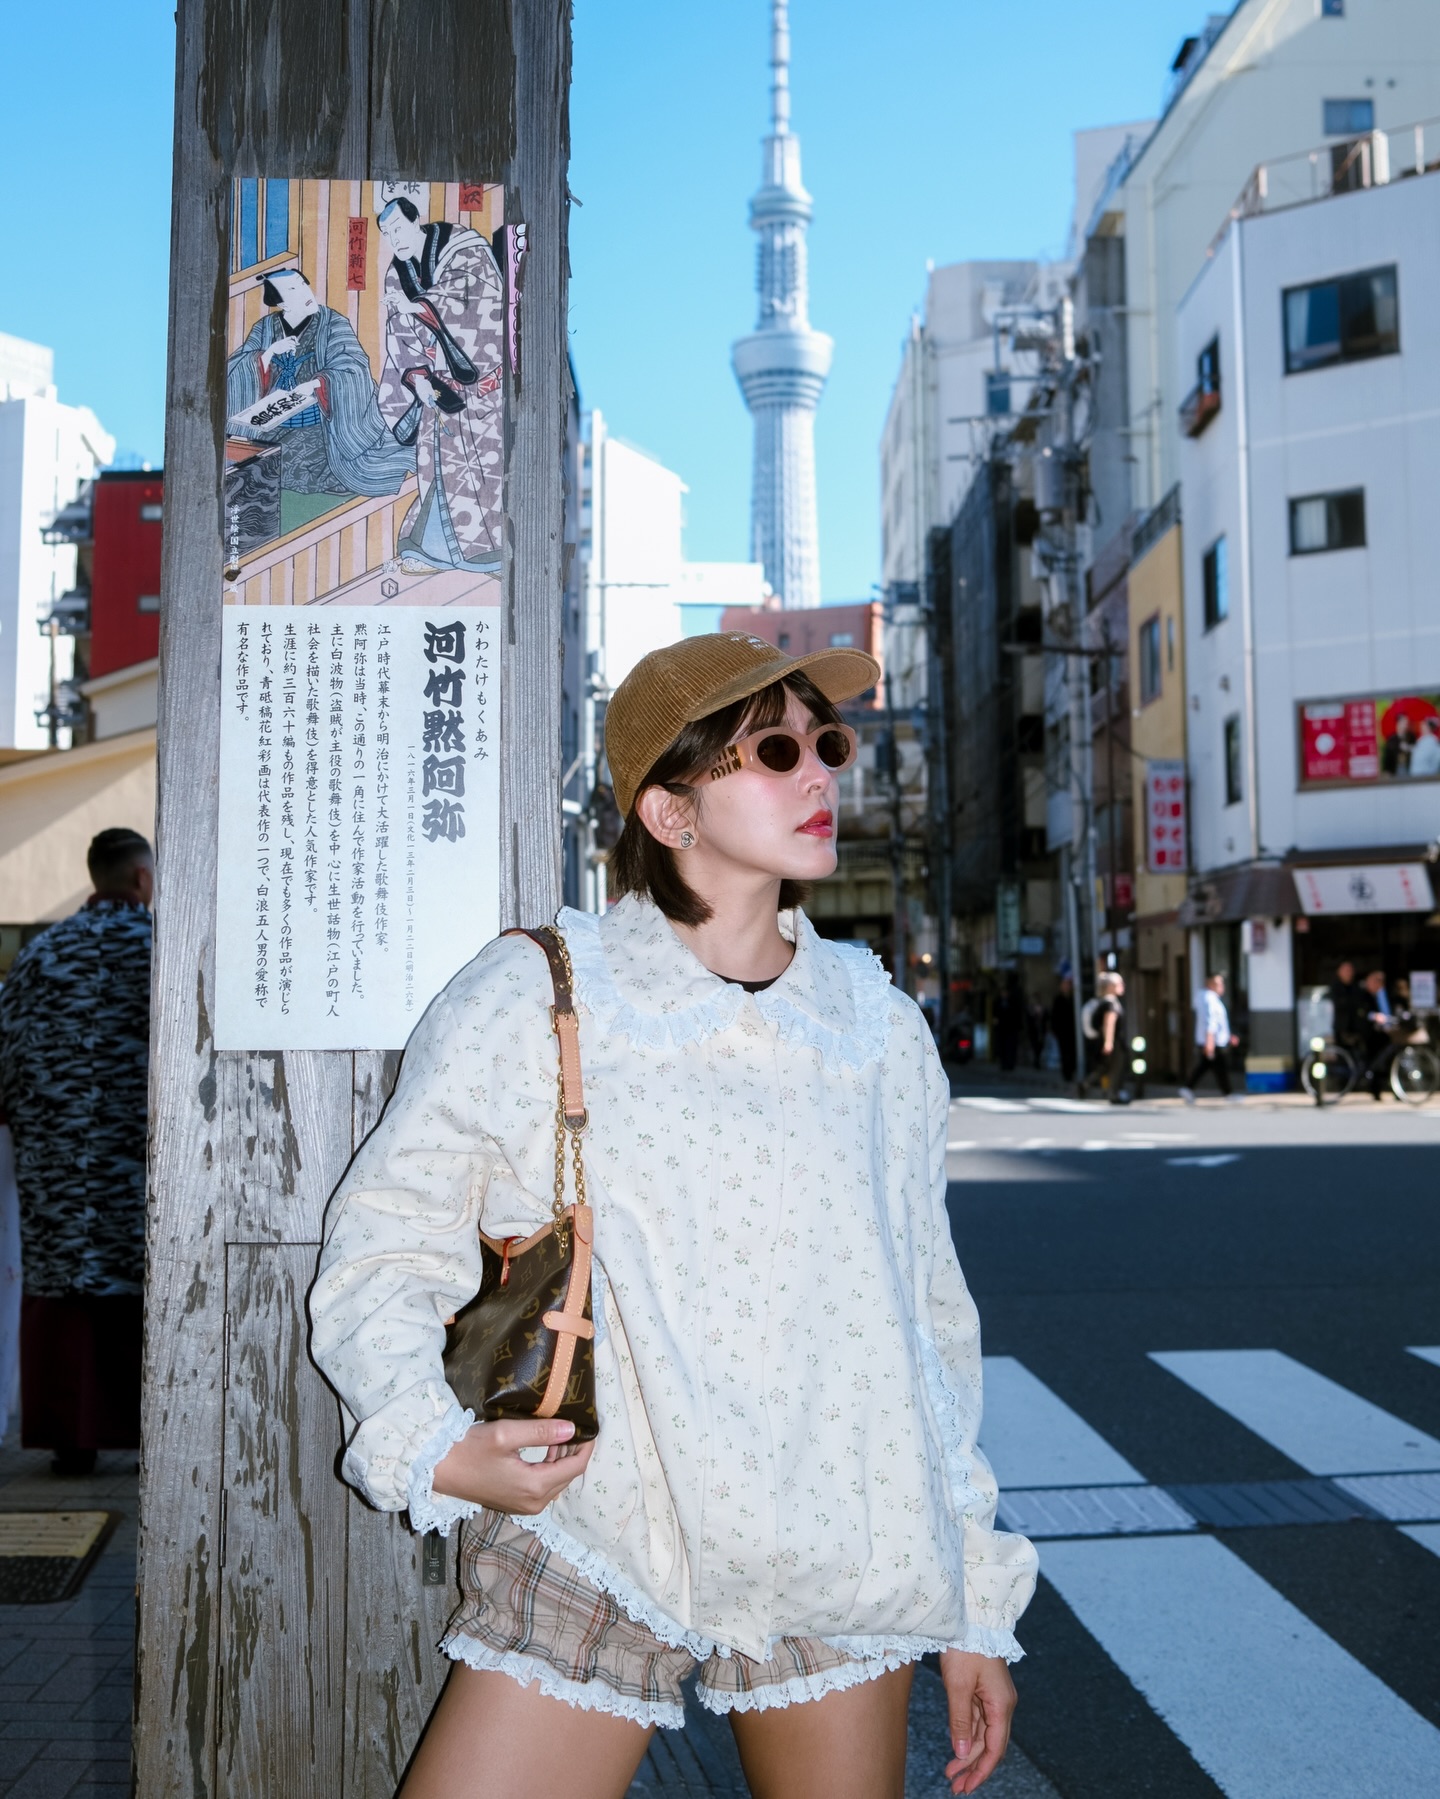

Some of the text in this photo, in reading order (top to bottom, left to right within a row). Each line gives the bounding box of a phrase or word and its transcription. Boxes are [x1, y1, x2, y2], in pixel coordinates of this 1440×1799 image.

[348, 220, 365, 284] 河竹新七
[236, 622, 250, 721] 有名な作品です。
[375, 624, 391, 952] 江戸時代幕末から明治にかけて大活躍した歌舞伎作家。
[422, 621, 465, 843] 河竹黙阿弥
[474, 621, 489, 760] かわたけもくあみ
[255, 622, 273, 1008] れており、青砥稿花紅彩画は代表作の一つで、白浪五人男の愛称で
[279, 623, 297, 1015] 生涯に約三百六十編もの作品を残し、現在でも多くの作品が演じら
[351, 623, 368, 999] 黙阿弥は当時、この通りの一角に住んで作家活動を行っていました。
